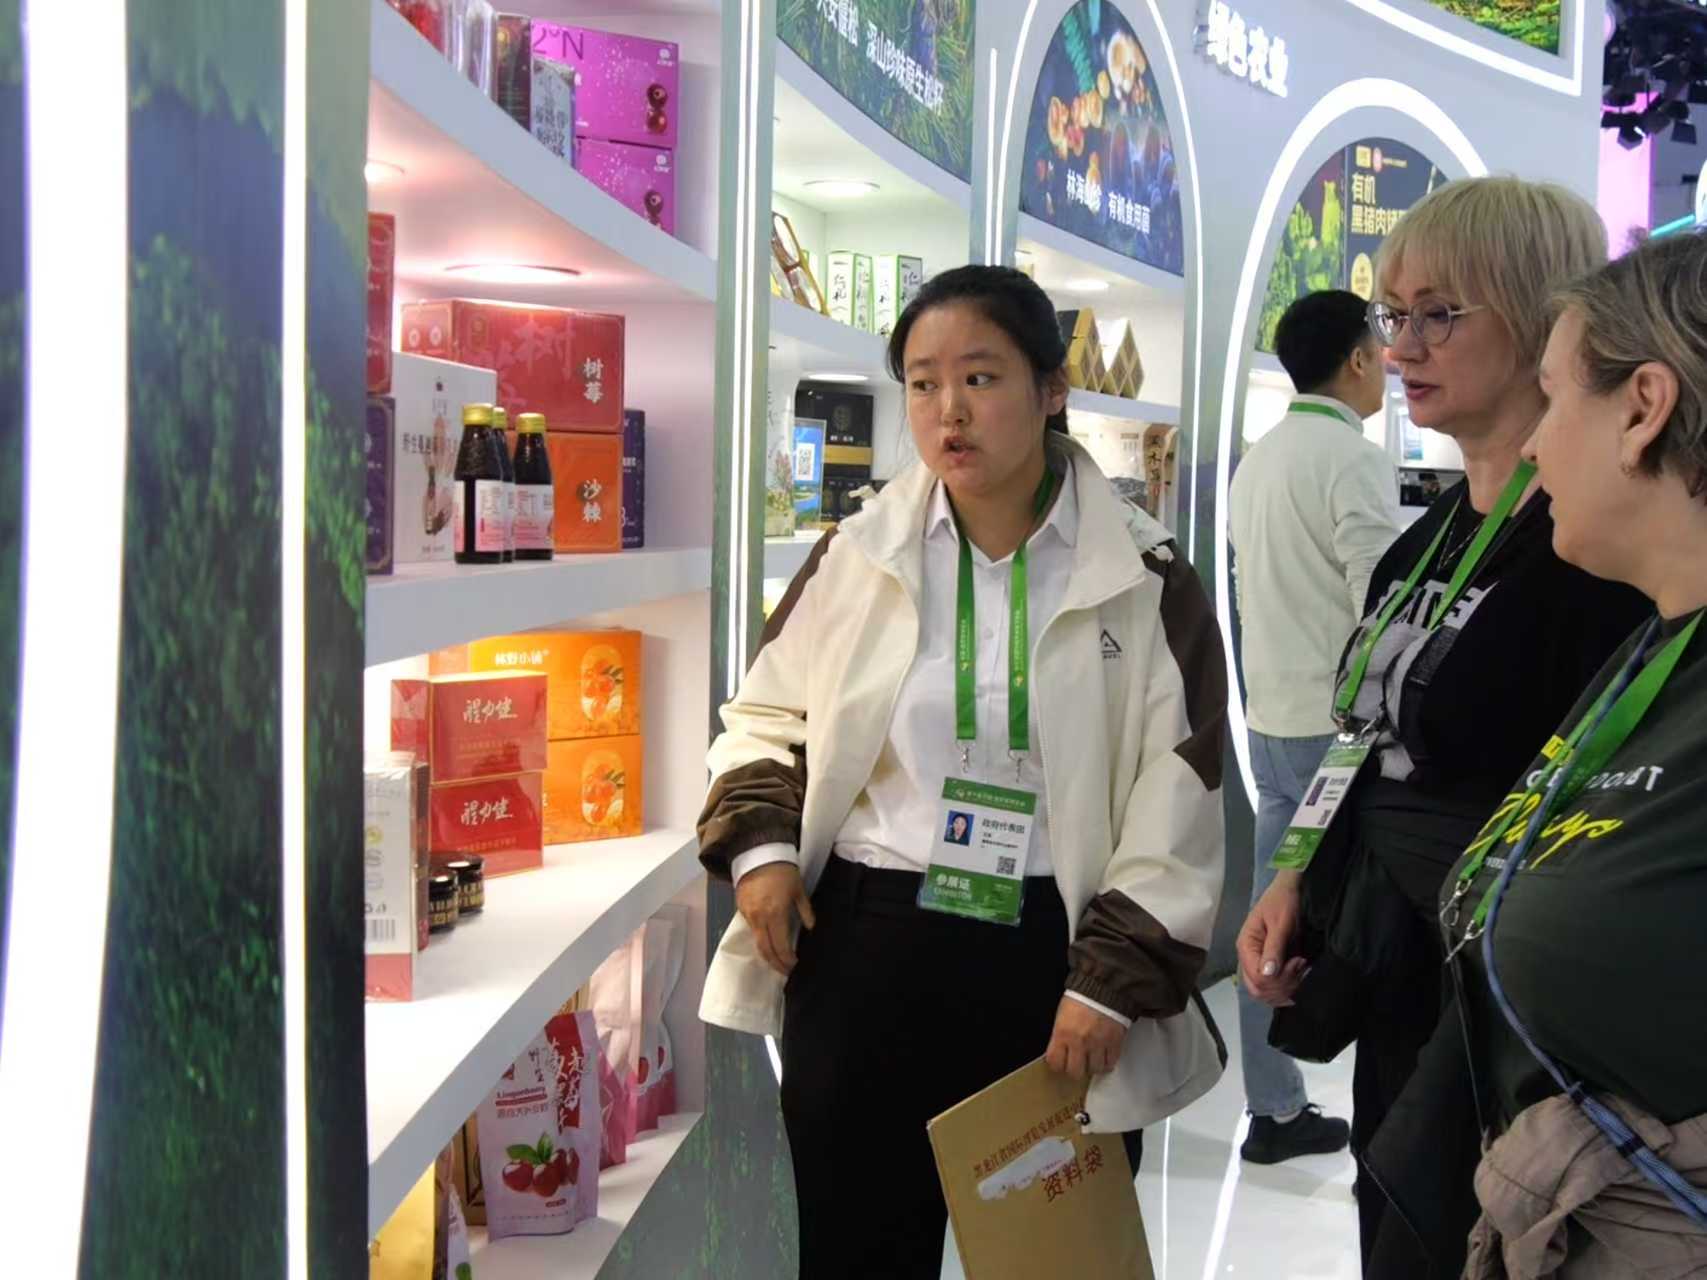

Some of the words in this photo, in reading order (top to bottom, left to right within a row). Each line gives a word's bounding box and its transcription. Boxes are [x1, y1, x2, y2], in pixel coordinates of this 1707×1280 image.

[1351, 171, 1376, 204] 有机
[583, 357, 605, 405] 树莓
[582, 479, 603, 524] 沙棘
[982, 817, 1025, 835] 政府代表团
[1041, 1144, 1105, 1203] 资料袋
